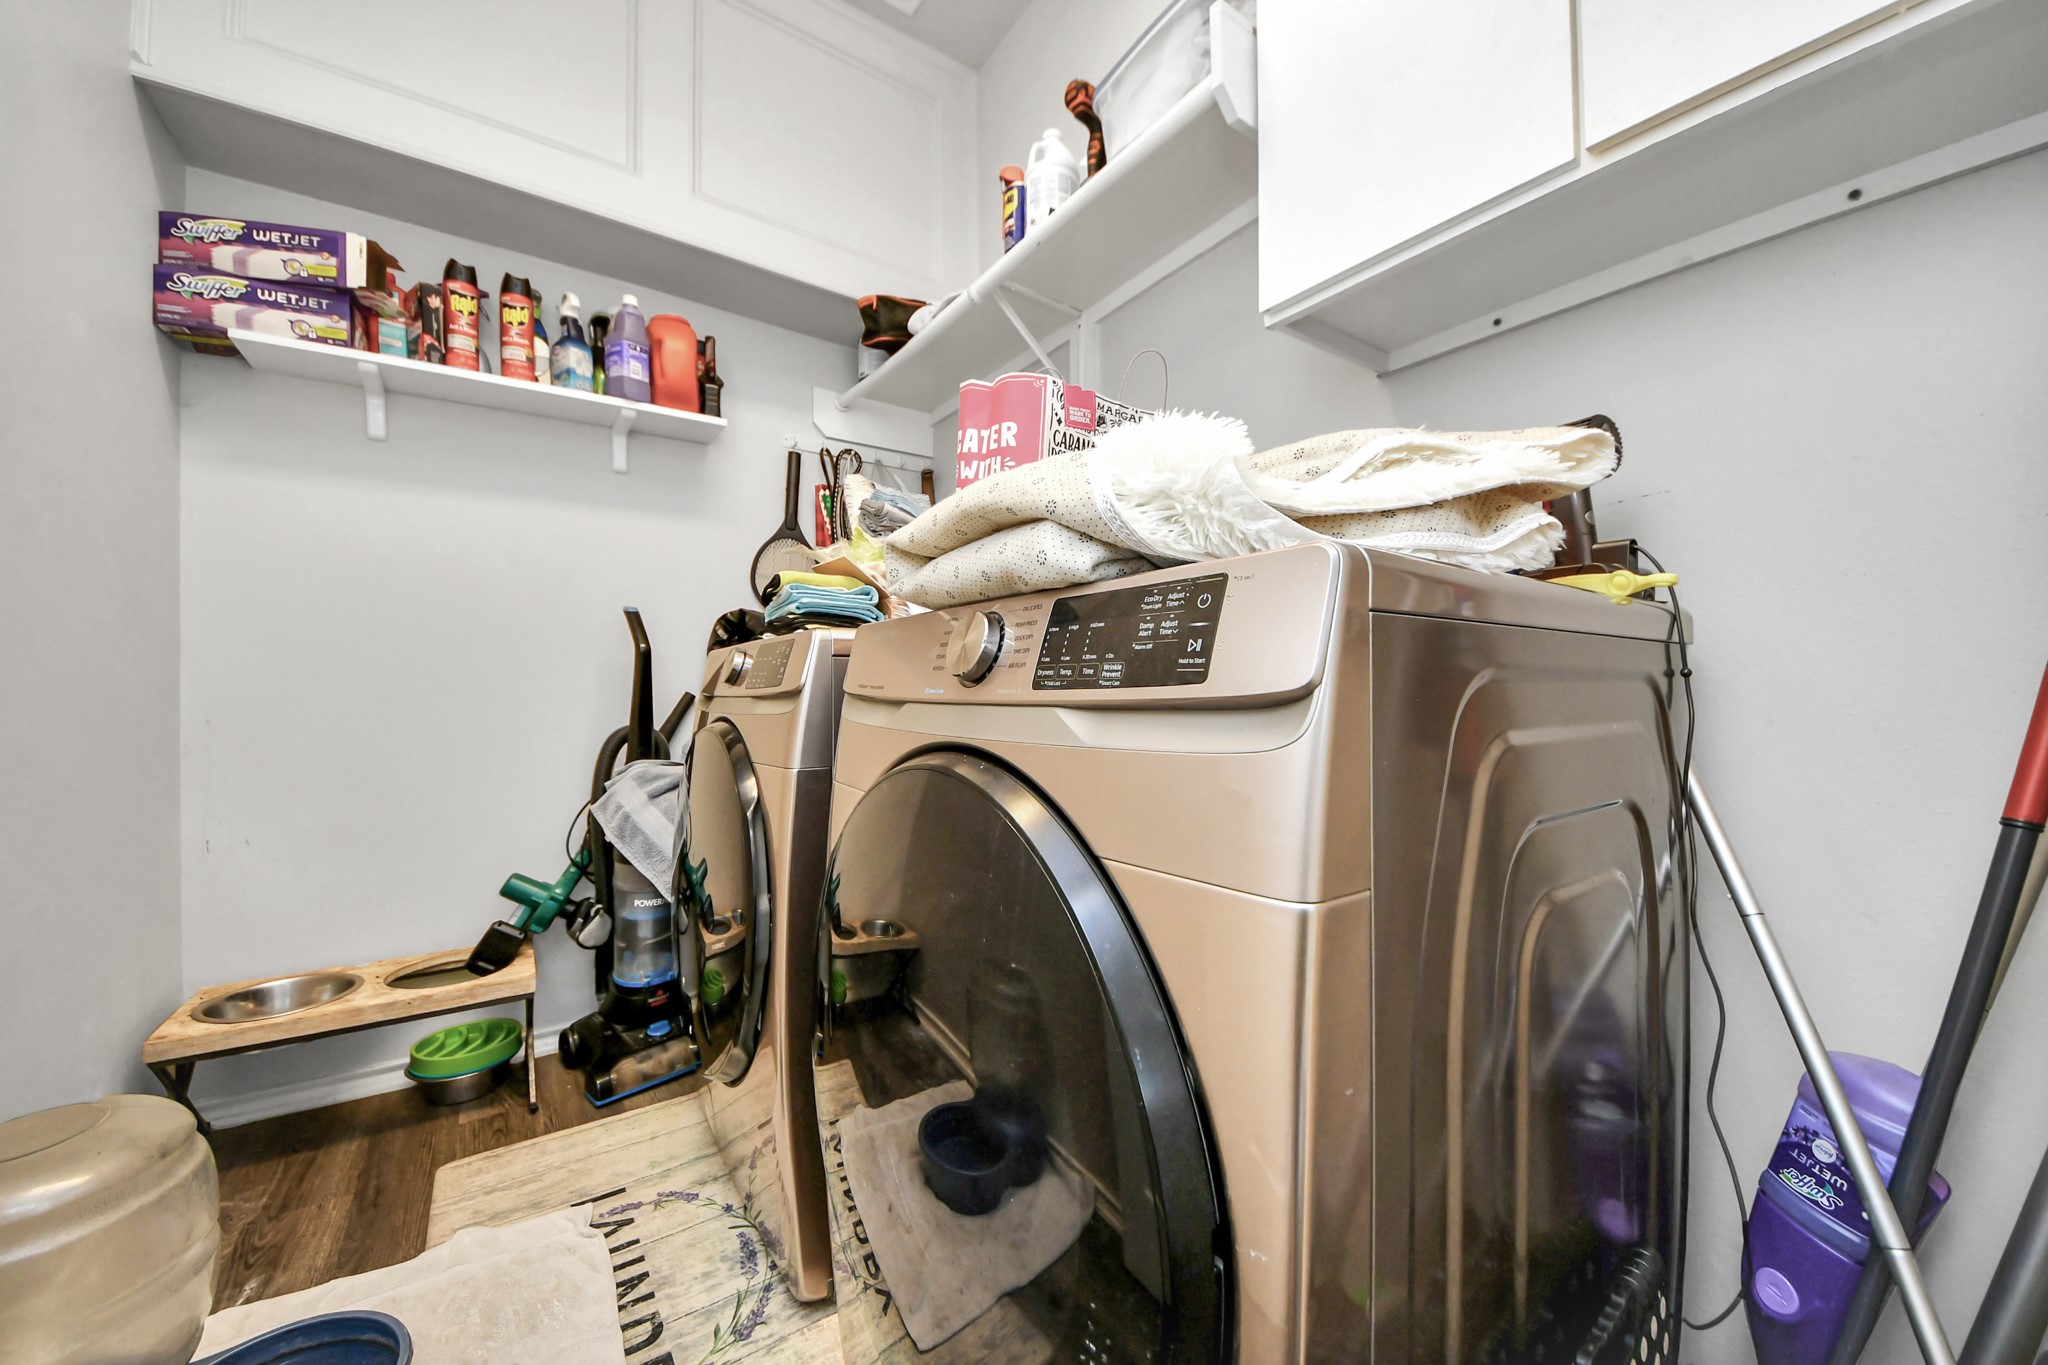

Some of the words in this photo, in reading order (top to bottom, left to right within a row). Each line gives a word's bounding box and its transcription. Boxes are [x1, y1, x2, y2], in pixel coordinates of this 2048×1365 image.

[171, 218, 243, 243] Swiffer
[252, 228, 321, 248] WETJET
[166, 272, 247, 299] Swiffer
[256, 288, 330, 310] WETJET
[450, 293, 478, 317] Raid
[502, 306, 530, 328] Raid
[960, 455, 1001, 480] WITH
[1167, 591, 1186, 600] Adjust
[1139, 622, 1155, 630] Damp
[1160, 620, 1179, 628] Adjust
[1138, 629, 1152, 637] Alert
[1159, 628, 1172, 636] Time
[1037, 669, 1054, 677] Dryness
[1082, 667, 1094, 675] Time
[1101, 670, 1121, 678] Prevent
[1103, 663, 1123, 671] Wrinkle
[1788, 1148, 1848, 1192] WETJET
[1782, 1167, 1844, 1210] Swiffer
